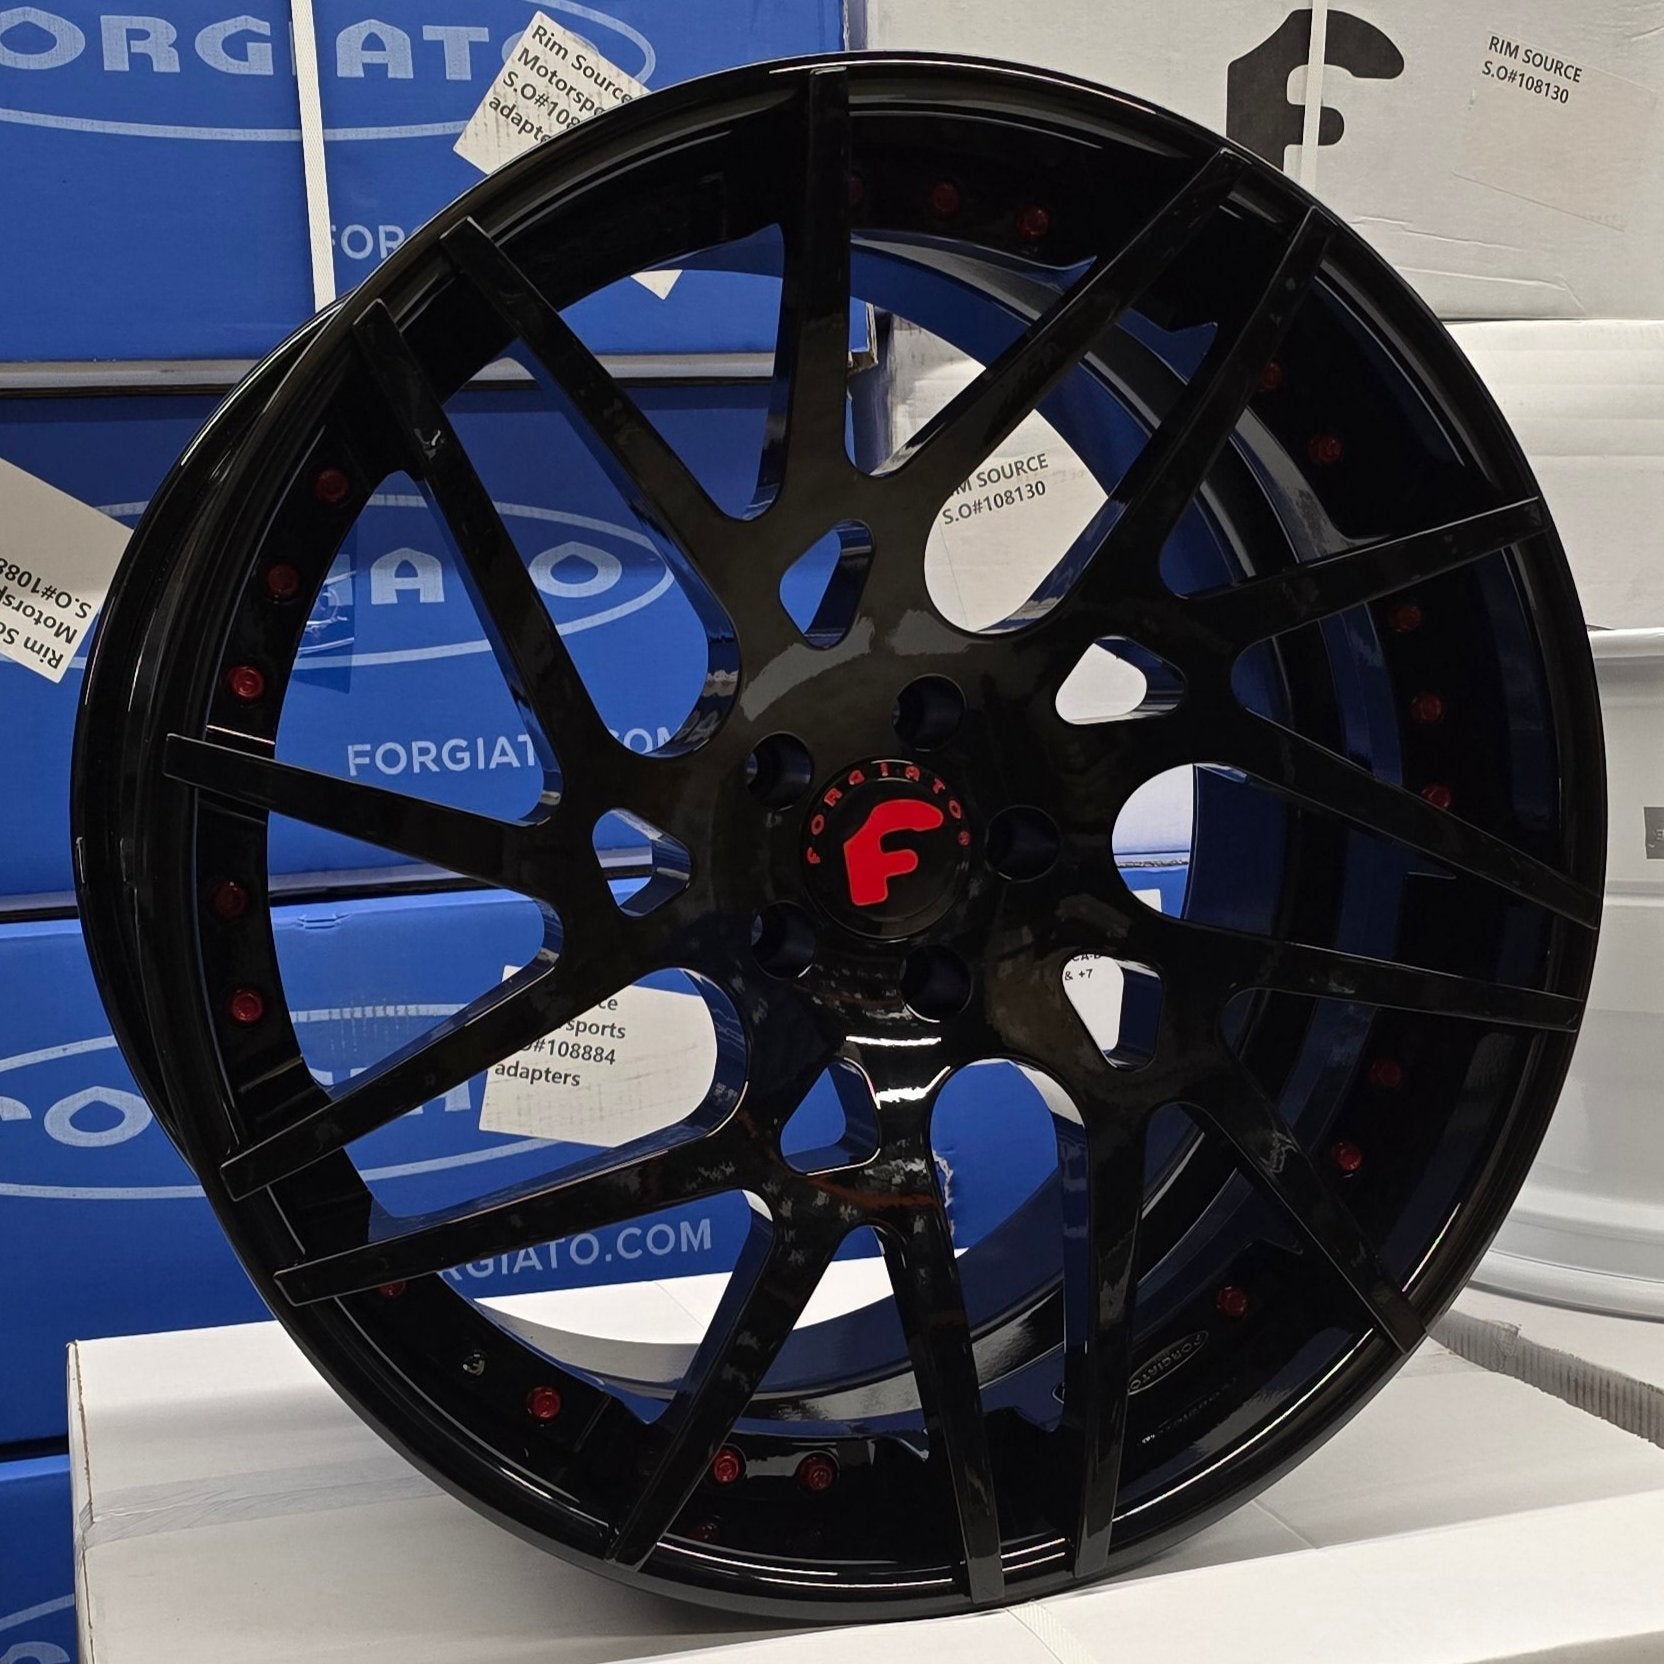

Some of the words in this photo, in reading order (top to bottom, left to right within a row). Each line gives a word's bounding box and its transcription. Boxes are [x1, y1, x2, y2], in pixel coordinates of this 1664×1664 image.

[532, 25, 569, 60] Rim
[571, 54, 633, 103] Source
[1482, 60, 1569, 103] S.O#108130
[1488, 36, 1520, 59] RIM
[1522, 49, 1583, 83] SOURCE
[976, 453, 1048, 488] SOURCE
[942, 480, 1046, 525] S.O#108130
[24, 636, 64, 669] Rim
[806, 762, 961, 864] FORGIATO
[843, 799, 944, 906] F
[558, 1018, 626, 1039] sports
[495, 1060, 581, 1087] adapters
